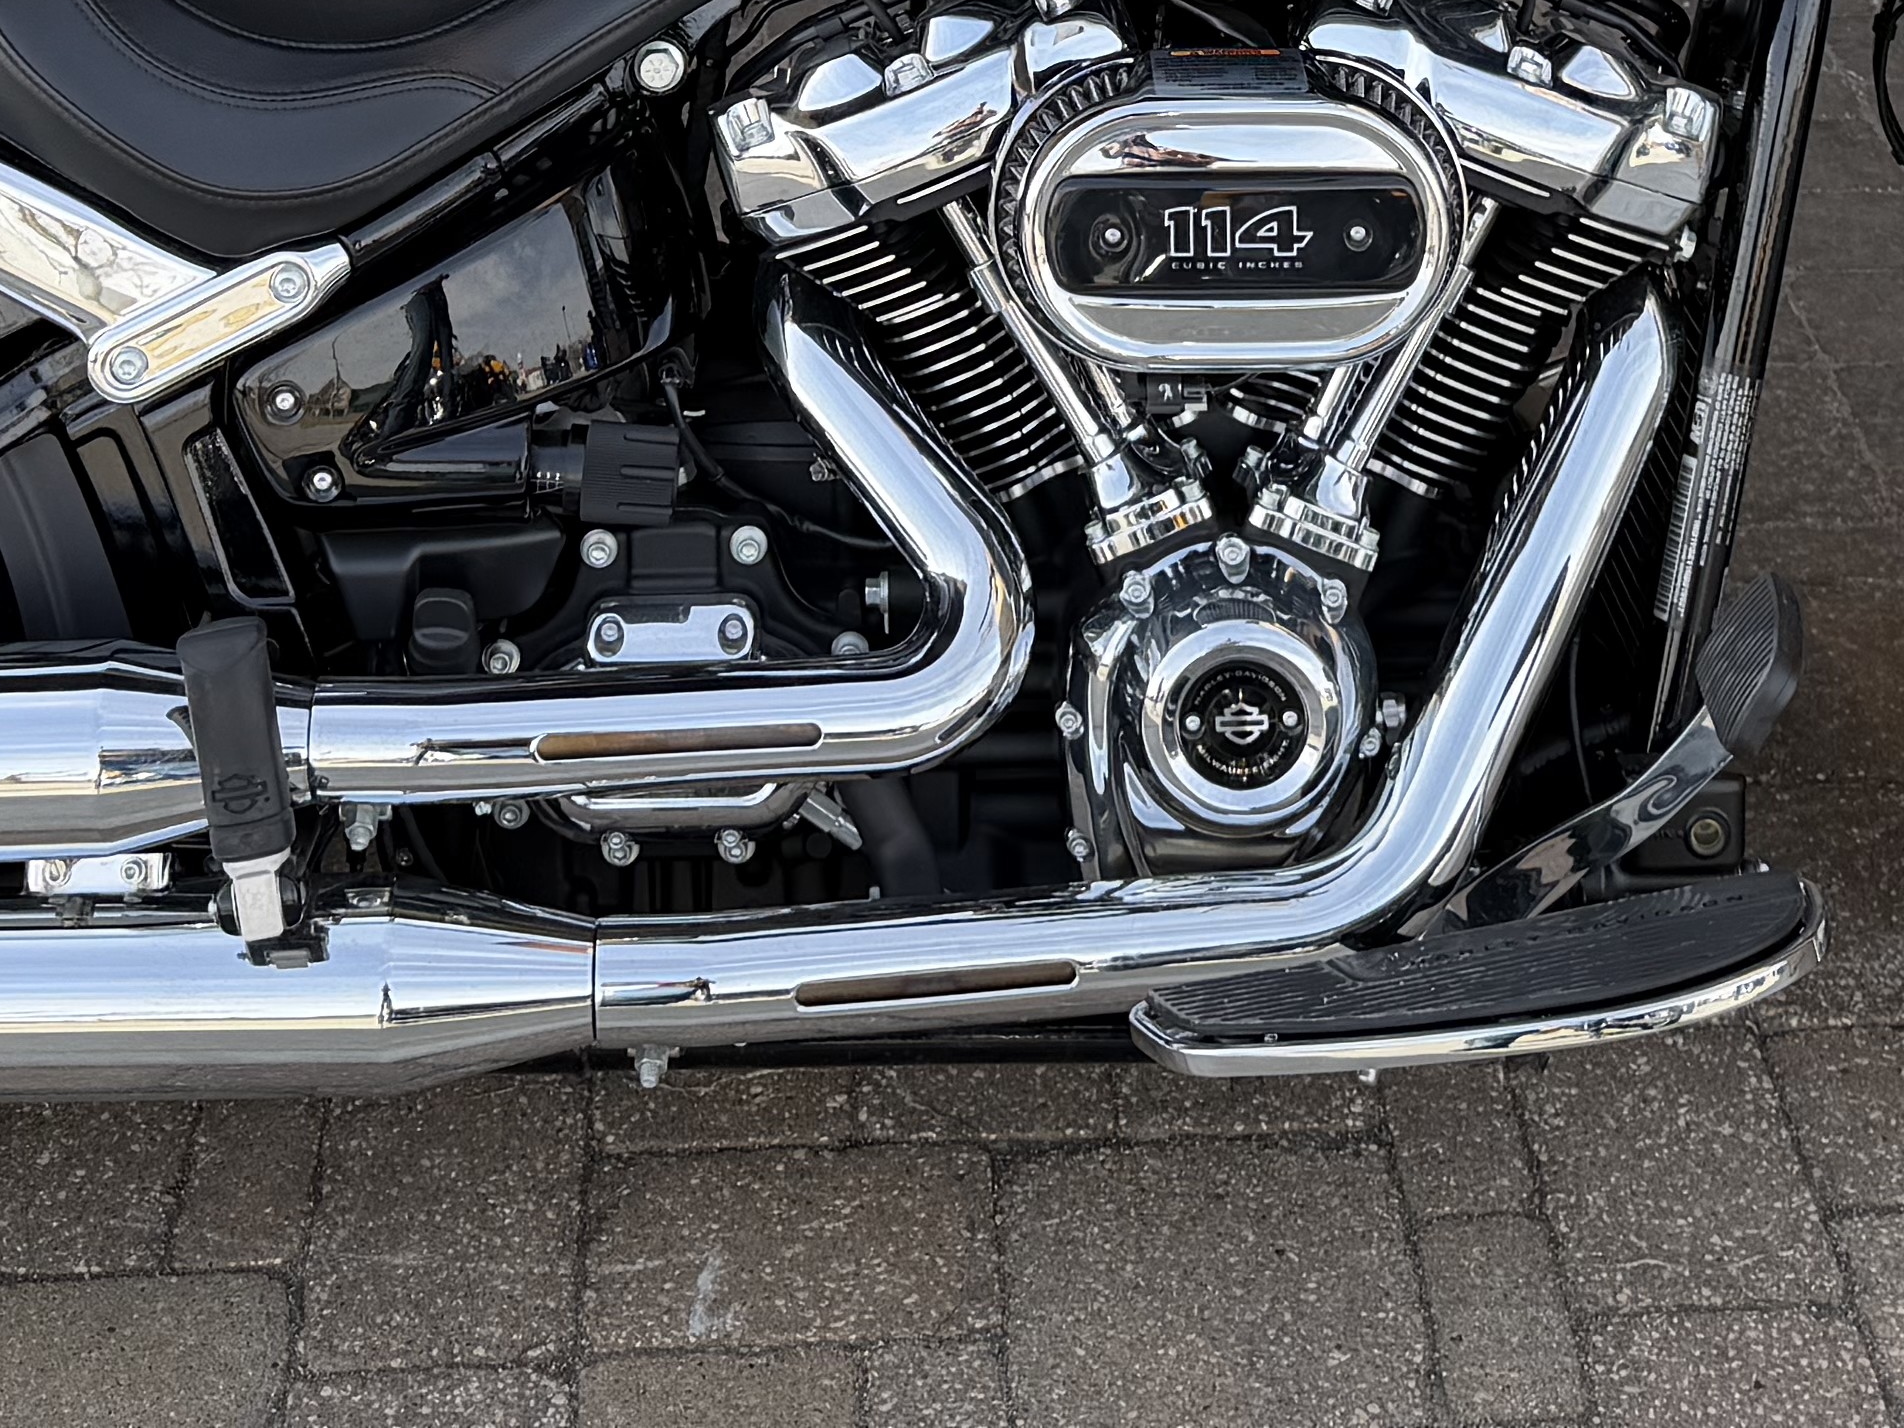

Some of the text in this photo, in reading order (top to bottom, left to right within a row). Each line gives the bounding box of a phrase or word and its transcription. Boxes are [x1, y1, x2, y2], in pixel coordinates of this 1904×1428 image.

[1164, 205, 1314, 258] 114
[1171, 261, 1304, 270] CUBIC INCHES
